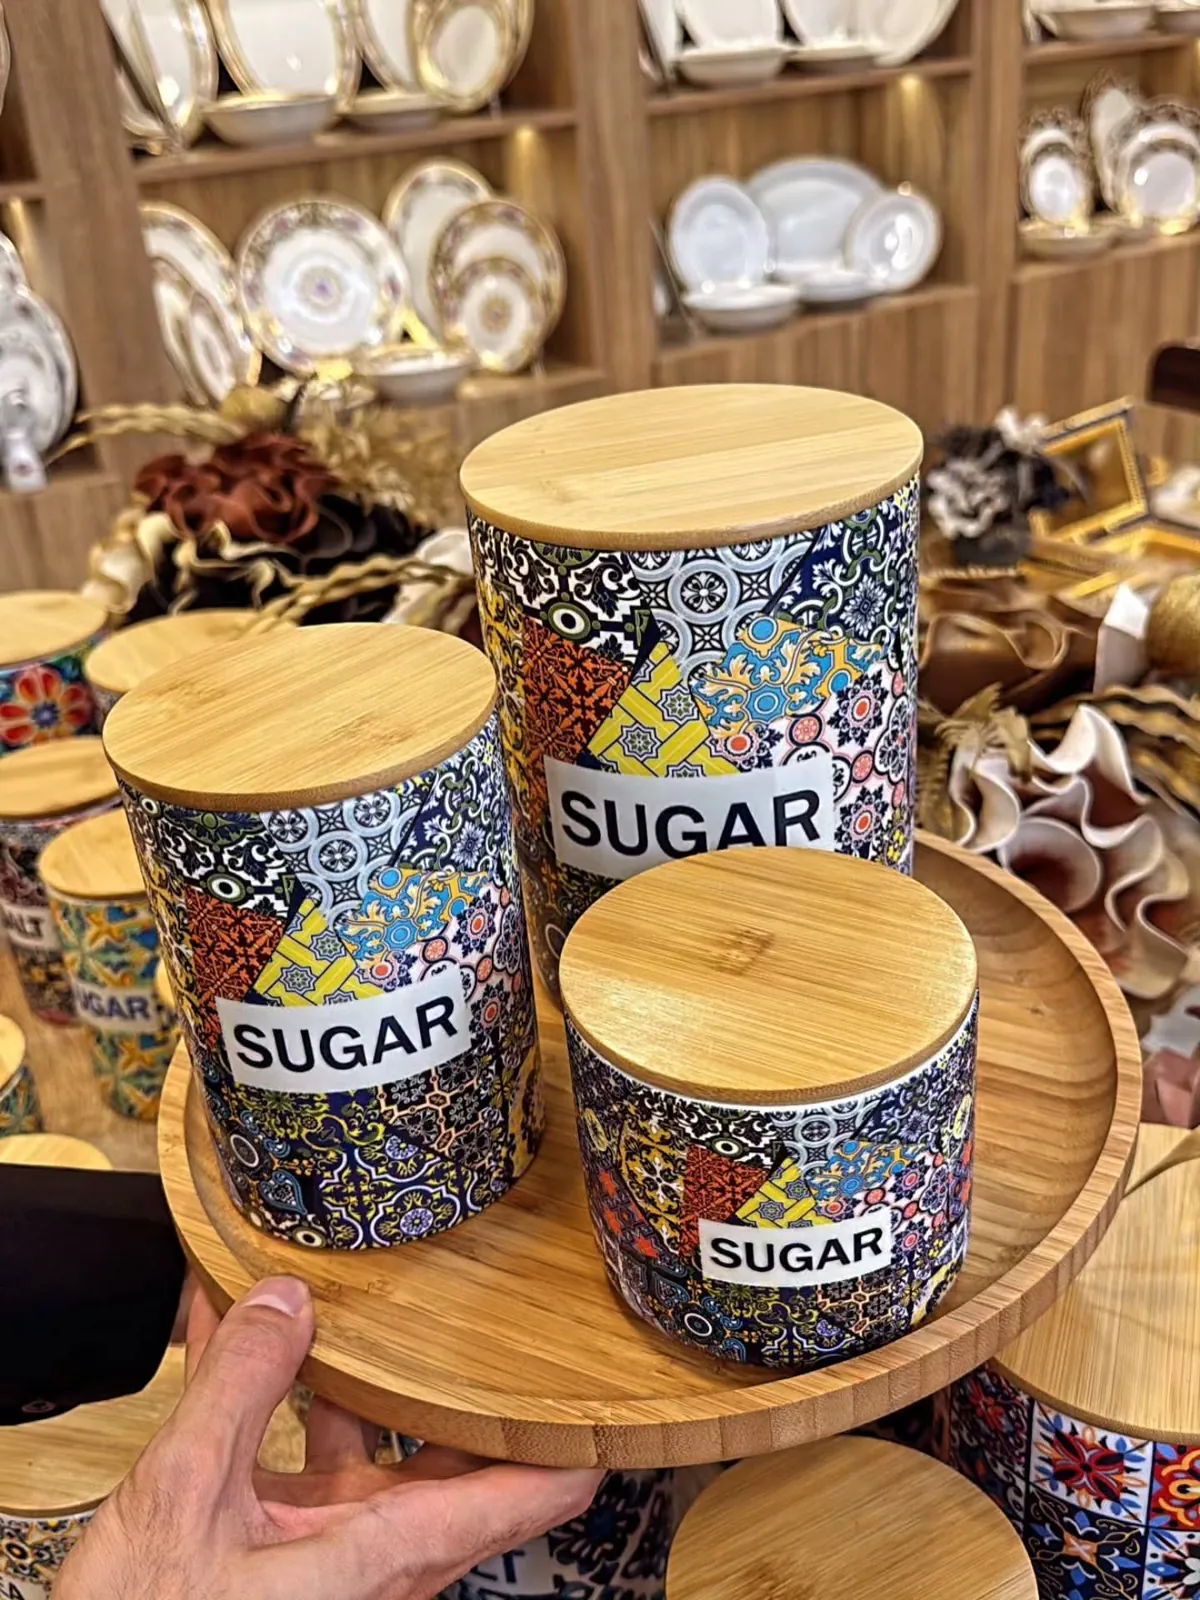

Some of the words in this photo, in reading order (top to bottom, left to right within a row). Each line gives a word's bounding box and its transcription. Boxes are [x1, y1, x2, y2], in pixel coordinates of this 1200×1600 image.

[560, 789, 820, 860] SUGAR
[233, 995, 458, 1073] SUGAR
[710, 1227, 883, 1273] SUGAR
